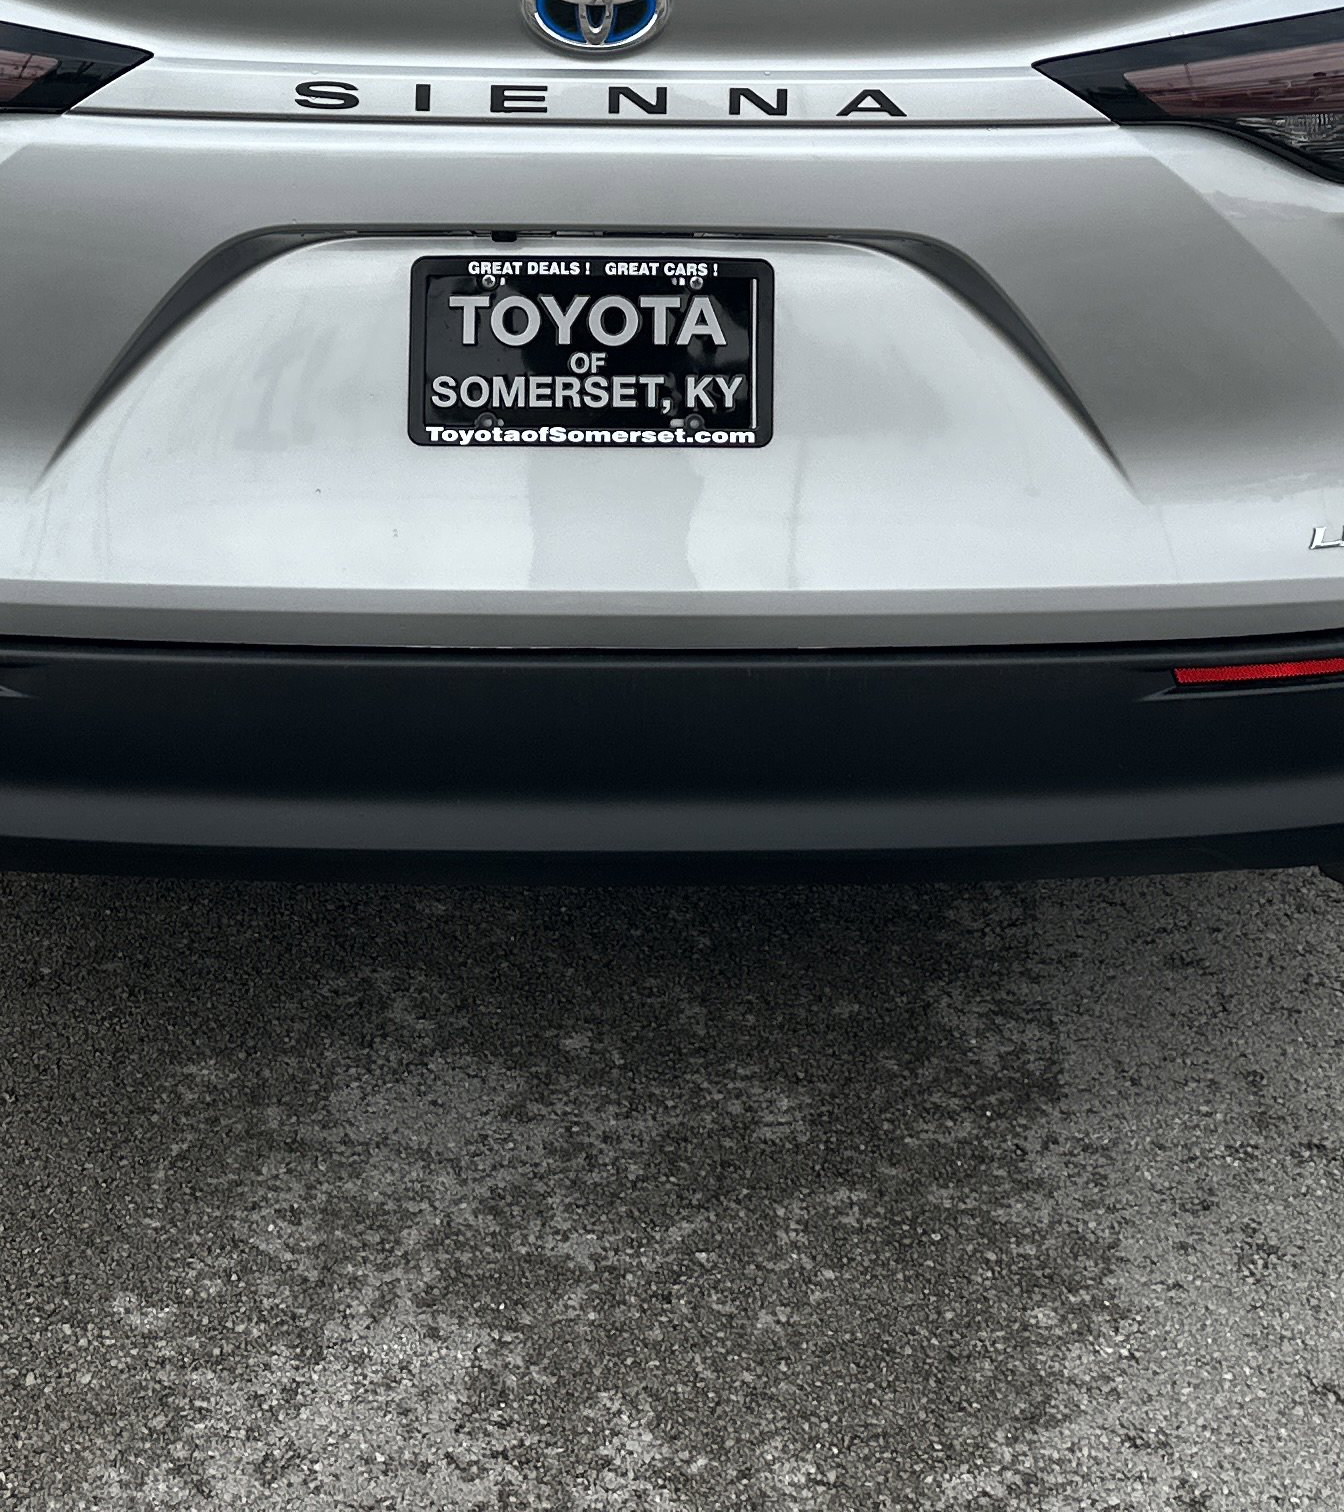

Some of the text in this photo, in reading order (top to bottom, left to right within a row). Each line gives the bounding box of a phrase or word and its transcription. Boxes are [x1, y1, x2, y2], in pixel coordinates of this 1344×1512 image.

[294, 80, 908, 117] SIENNA
[468, 261, 522, 275] GREAT
[527, 262, 581, 275] DEALS
[605, 262, 659, 276] GREAT
[663, 263, 708, 276] CARS
[449, 295, 727, 347] TOYOTA
[570, 352, 606, 374] OF
[431, 375, 743, 415] SOMERSET, KY
[425, 426, 755, 446] ToyotaofSomerset.com
